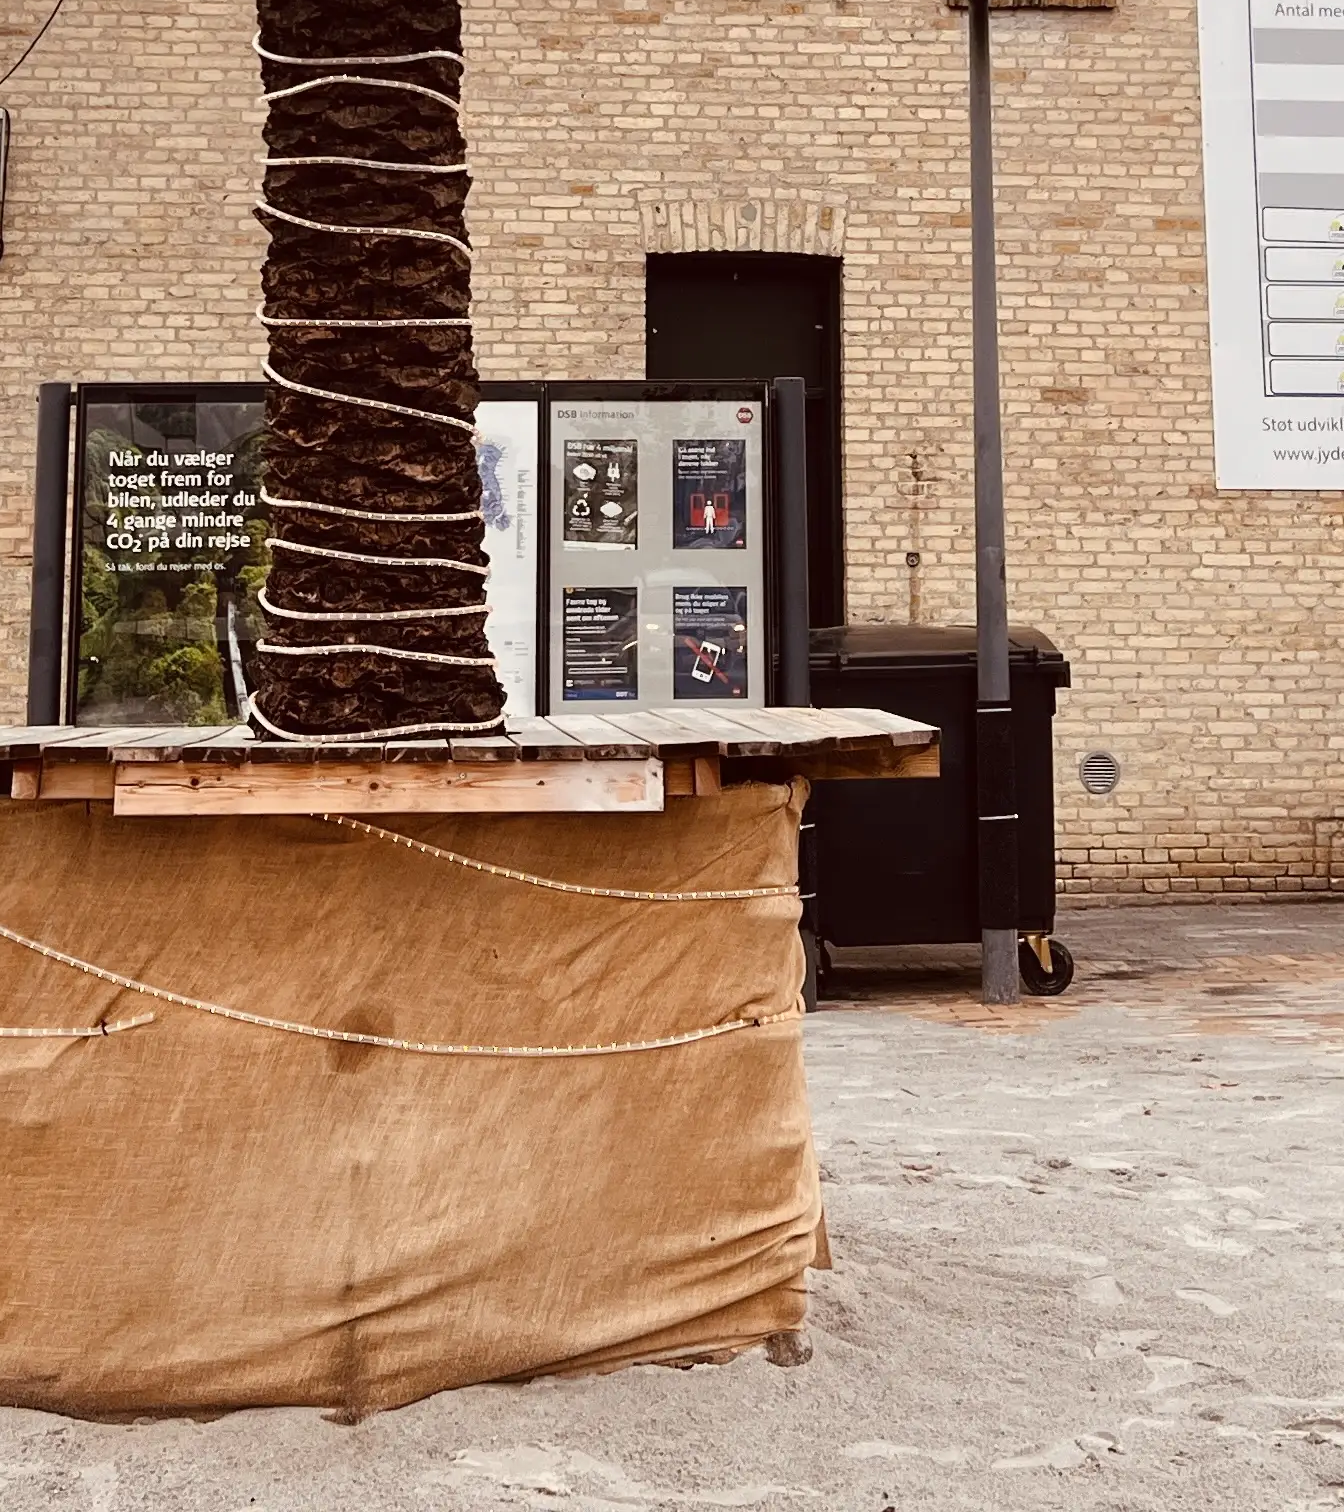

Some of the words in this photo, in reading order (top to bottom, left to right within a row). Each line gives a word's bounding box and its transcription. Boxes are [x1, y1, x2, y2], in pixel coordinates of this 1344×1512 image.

[1275, 3, 1313, 17] Antal
[557, 410, 577, 418] DSB
[1262, 417, 1293, 432] Støt
[109, 450, 142, 466] Når
[146, 450, 169, 466] du
[174, 450, 234, 468] vælger
[108, 473, 156, 490] toget
[160, 470, 202, 487] frem
[207, 470, 233, 486] for
[108, 492, 156, 509] bilen,
[162, 491, 229, 507] udleder
[233, 490, 255, 506] du
[106, 513, 118, 528] 4
[124, 514, 176, 531] gange
[182, 511, 244, 528] mindre
[148, 532, 170, 552] på
[175, 532, 202, 548] din
[208, 533, 251, 551] rejse
[105, 563, 116, 571] Så
[118, 563, 133, 572] tak,
[136, 563, 155, 571] fordi
[157, 563, 167, 571] du
[170, 563, 192, 572] rejser
[194, 562, 212, 571] med
